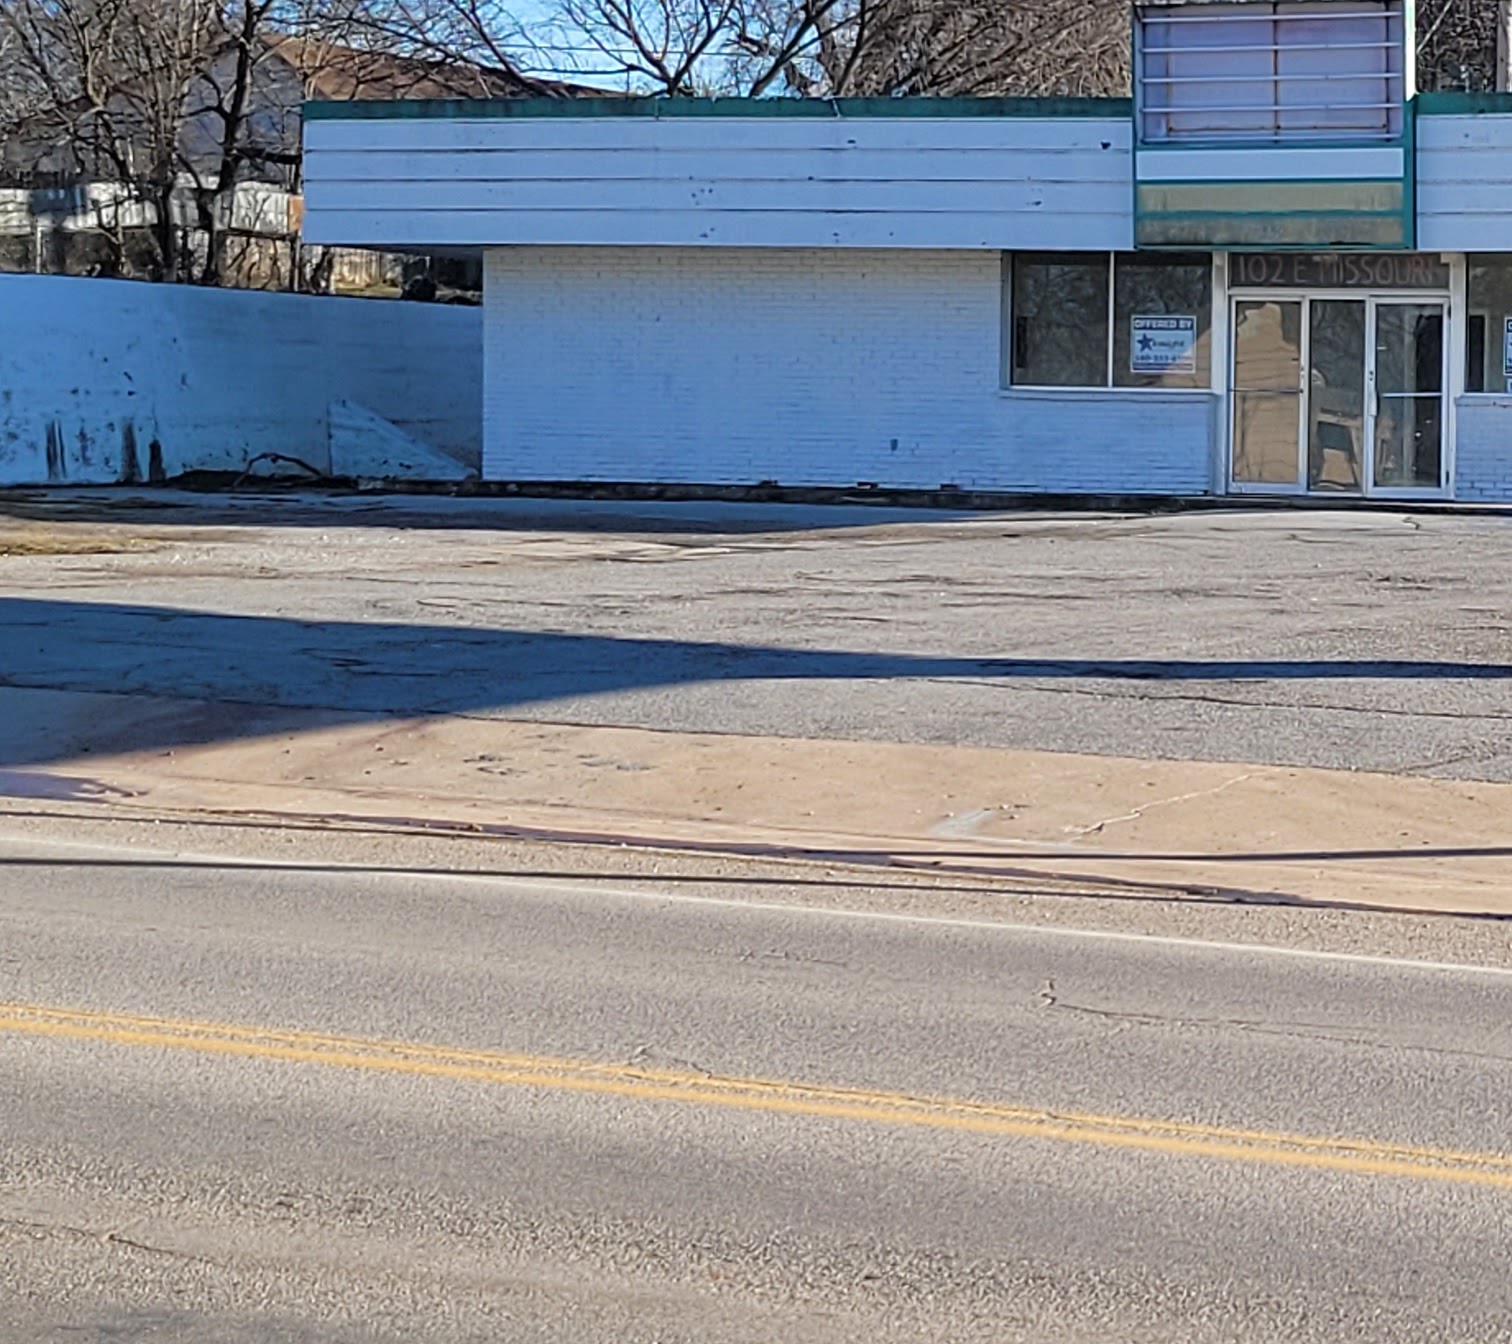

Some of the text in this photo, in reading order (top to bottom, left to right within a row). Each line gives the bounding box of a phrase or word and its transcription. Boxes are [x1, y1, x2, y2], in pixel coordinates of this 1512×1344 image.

[1239, 254, 1434, 285] 102 E MISSOURI
